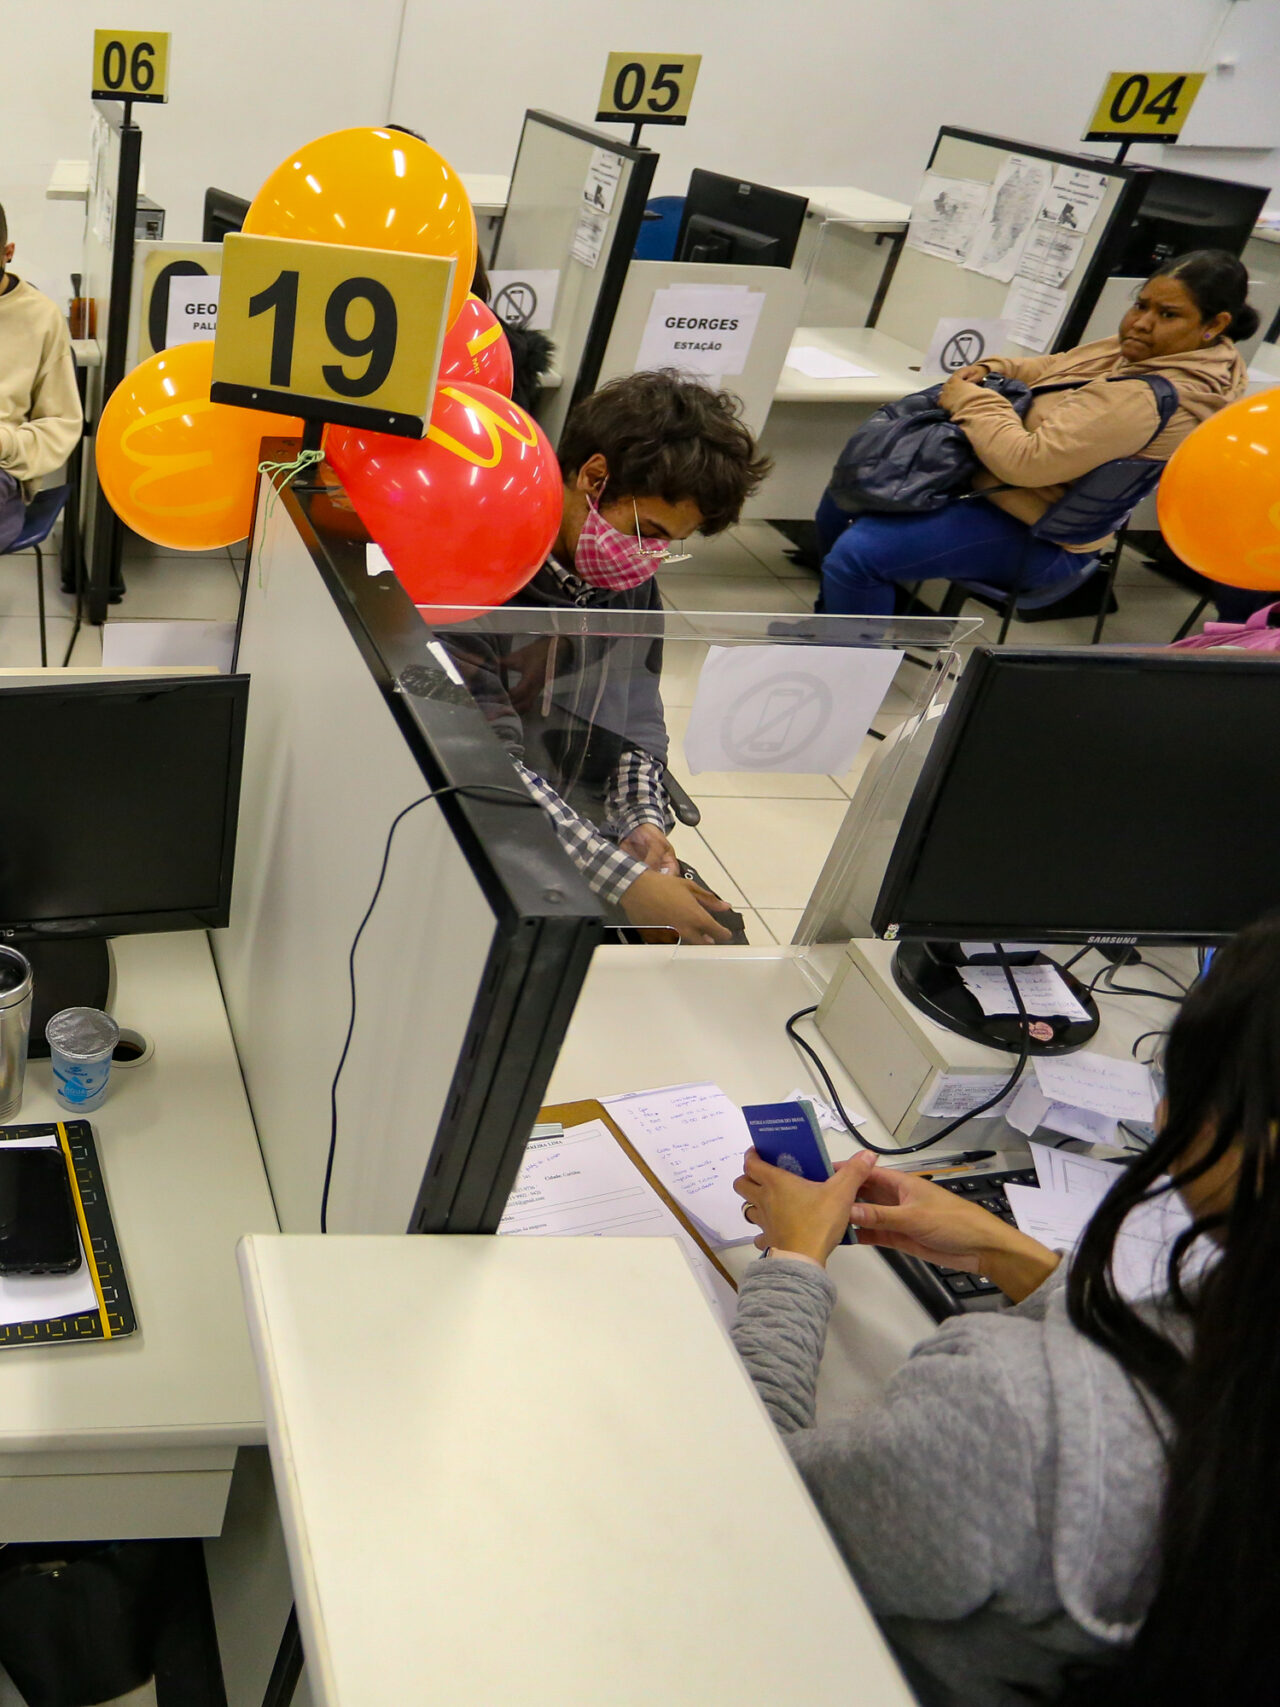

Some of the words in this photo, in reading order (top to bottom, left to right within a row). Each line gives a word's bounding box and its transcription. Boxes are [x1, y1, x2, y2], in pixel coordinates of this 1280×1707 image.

[102, 40, 155, 91] 06
[613, 62, 684, 112] 05
[1109, 74, 1187, 124] 04
[185, 303, 217, 315] GEO
[665, 317, 739, 331] GEORGES
[248, 270, 398, 397] 19
[673, 341, 723, 352] ESTAÇÃO
[1087, 936, 1138, 945] SAMSUNG
